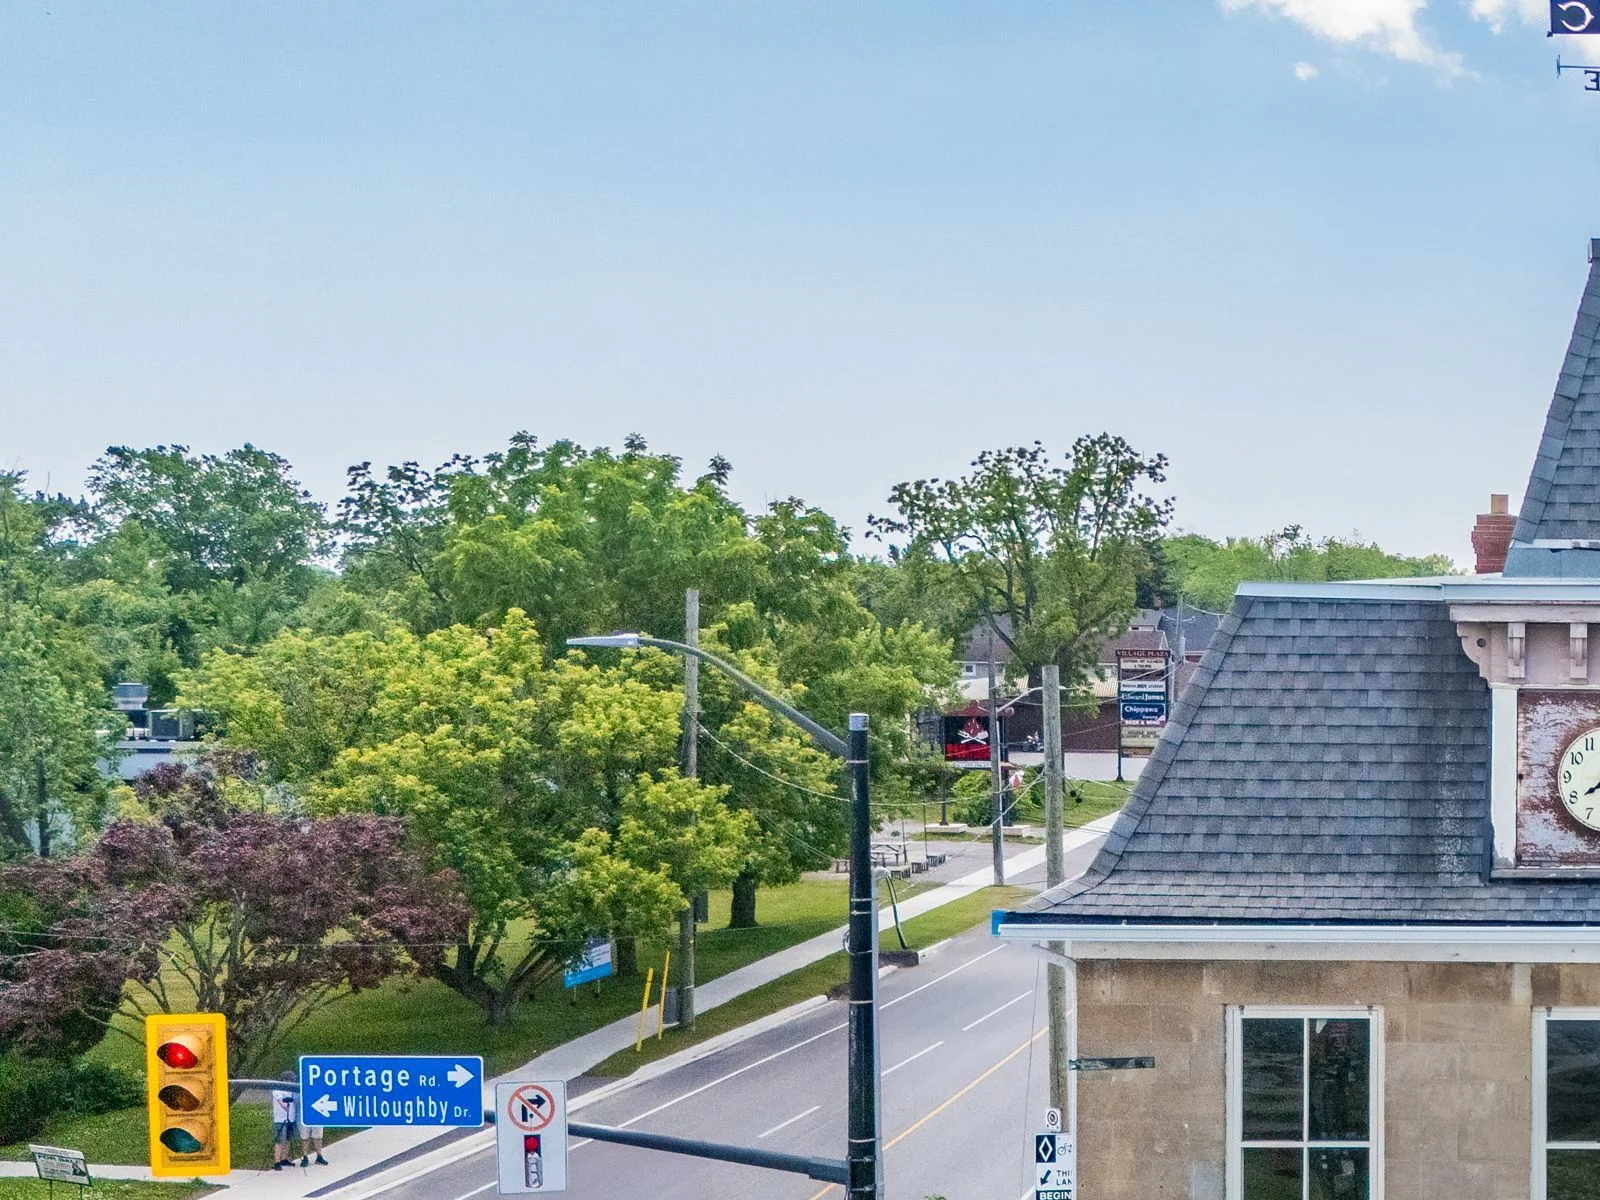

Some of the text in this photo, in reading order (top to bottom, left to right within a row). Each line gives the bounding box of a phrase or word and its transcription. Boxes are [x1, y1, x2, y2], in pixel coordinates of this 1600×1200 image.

[1124, 705, 1159, 714] Chippawa
[1585, 737, 1594, 751] 11
[1571, 751, 1584, 765] 10
[1563, 771, 1572, 784] 9
[1569, 791, 1578, 805] 8
[1585, 807, 1594, 820] 7
[308, 1064, 441, 1092] Portage Rd.
[343, 1095, 472, 1124] Willoughby Dr.
[1056, 1169, 1072, 1177] THI
